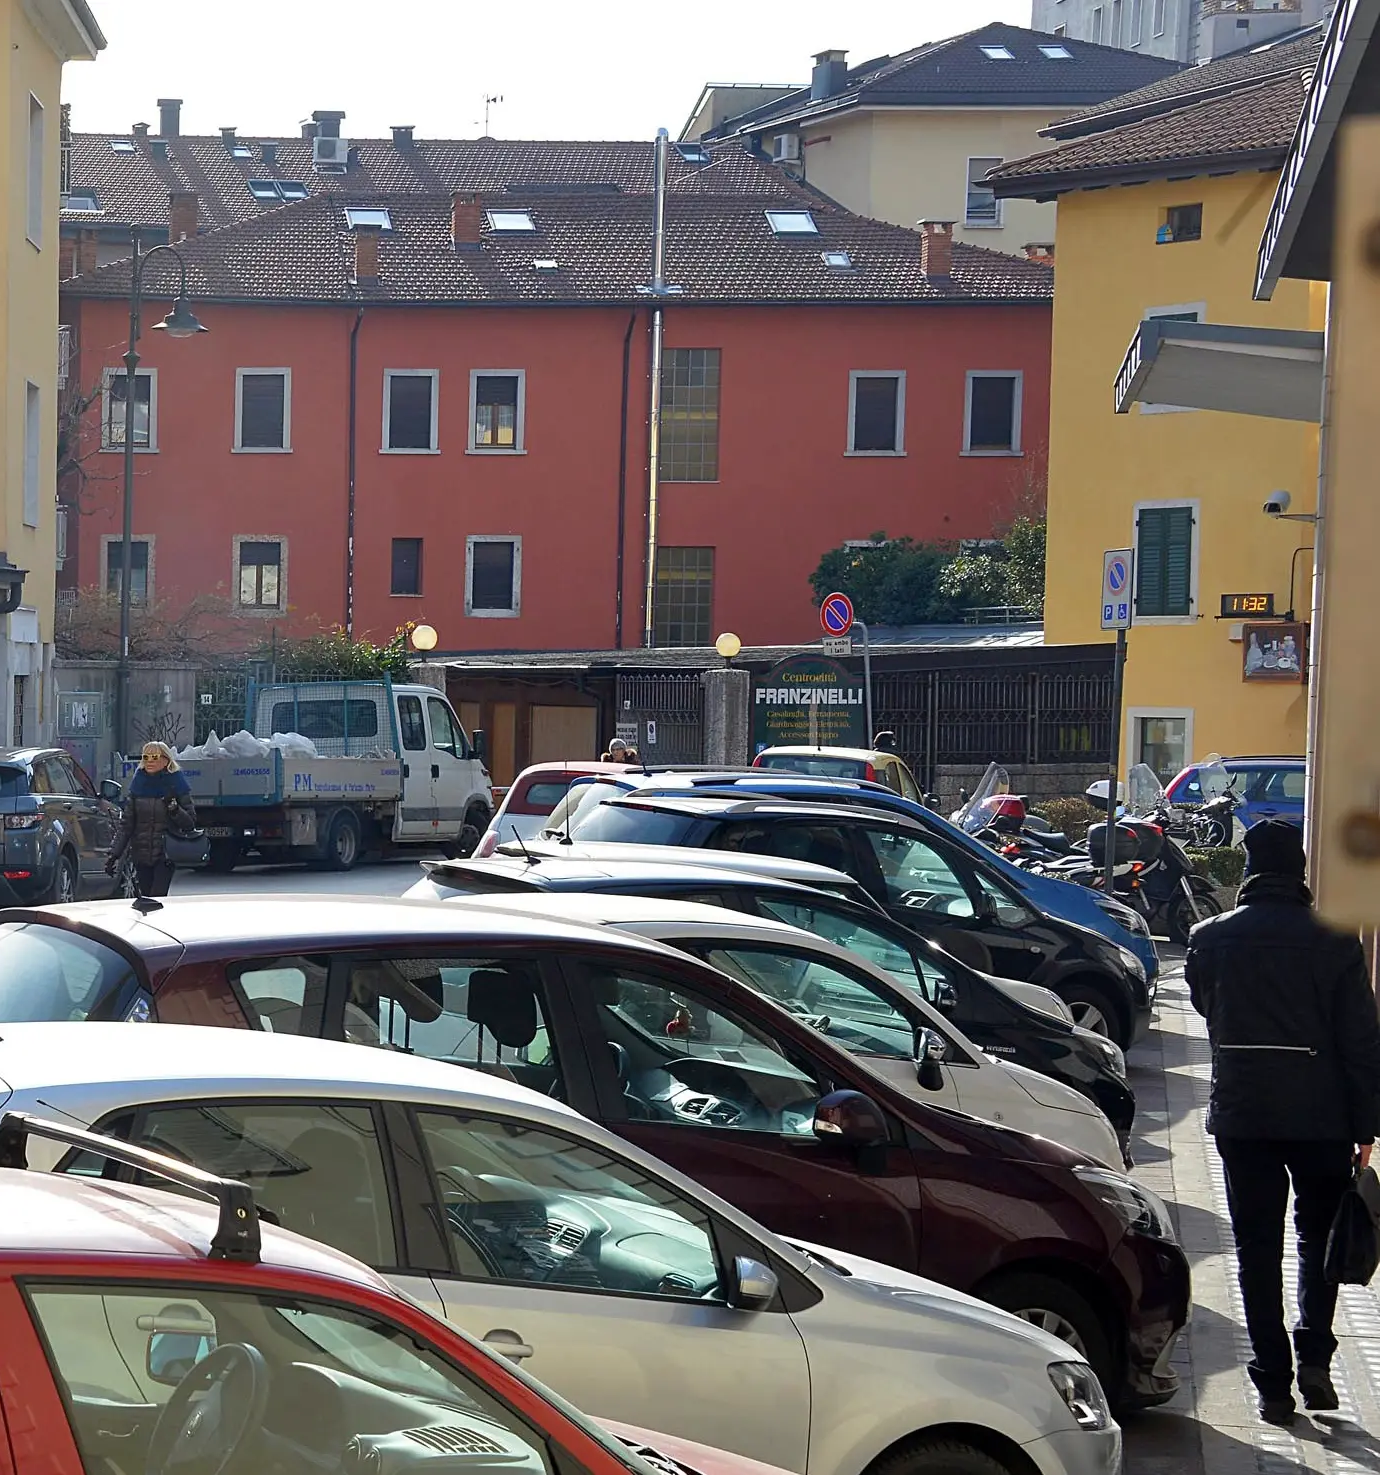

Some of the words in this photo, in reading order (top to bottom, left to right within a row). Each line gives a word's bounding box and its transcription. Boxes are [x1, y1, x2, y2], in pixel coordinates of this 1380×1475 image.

[1232, 596, 1267, 611] 11:32
[755, 688, 863, 705] FRANZINELLI
[294, 773, 312, 791] PM
